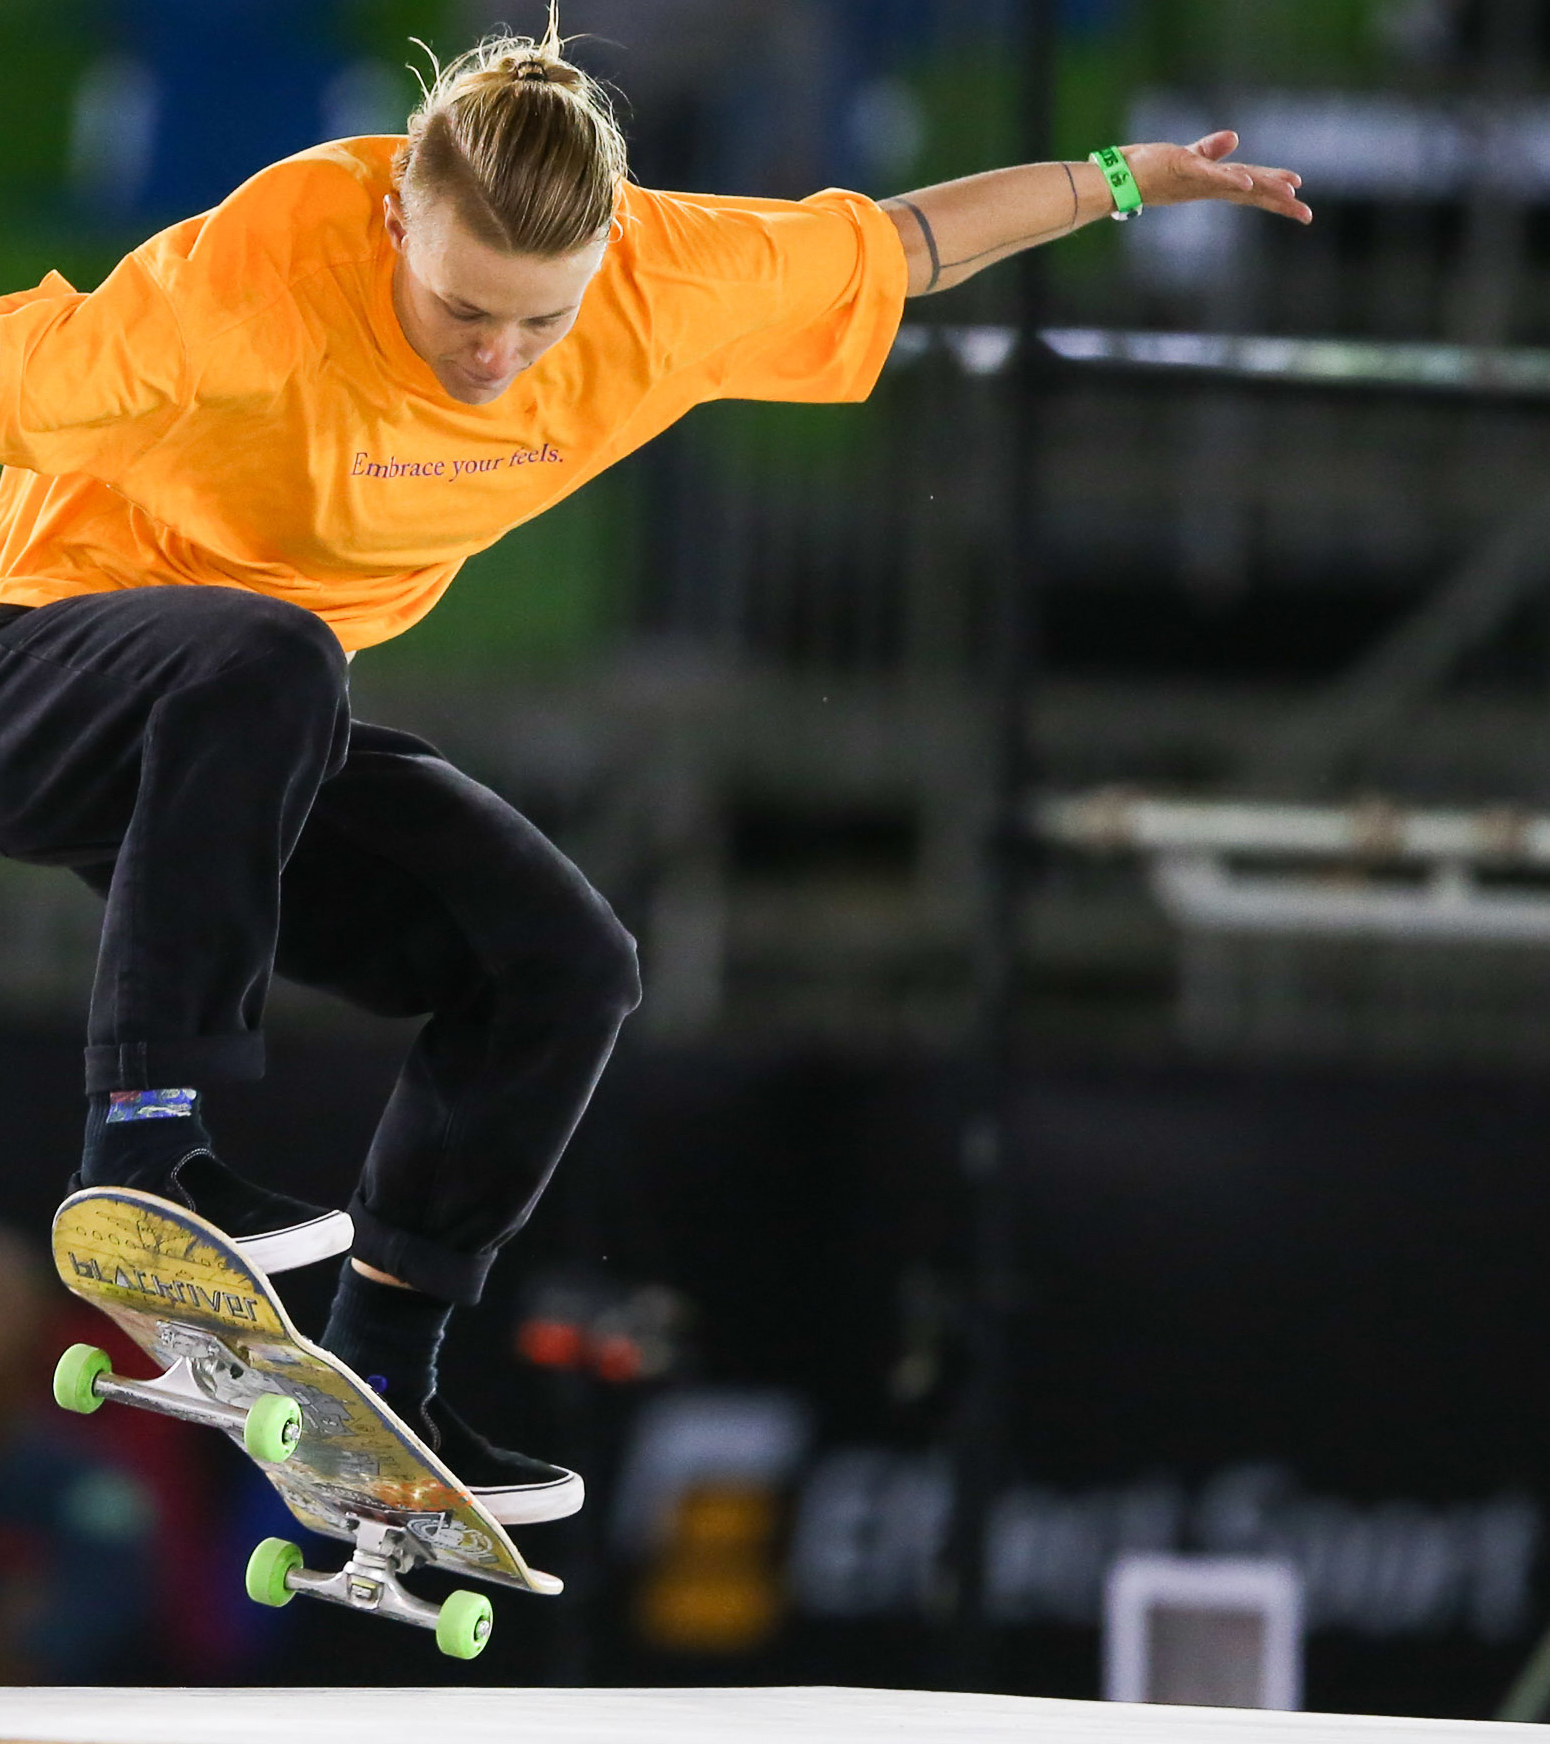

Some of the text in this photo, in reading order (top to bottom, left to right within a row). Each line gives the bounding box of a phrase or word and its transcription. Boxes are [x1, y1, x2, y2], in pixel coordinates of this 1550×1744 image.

[351, 442, 563, 483] Embrace your feels.
